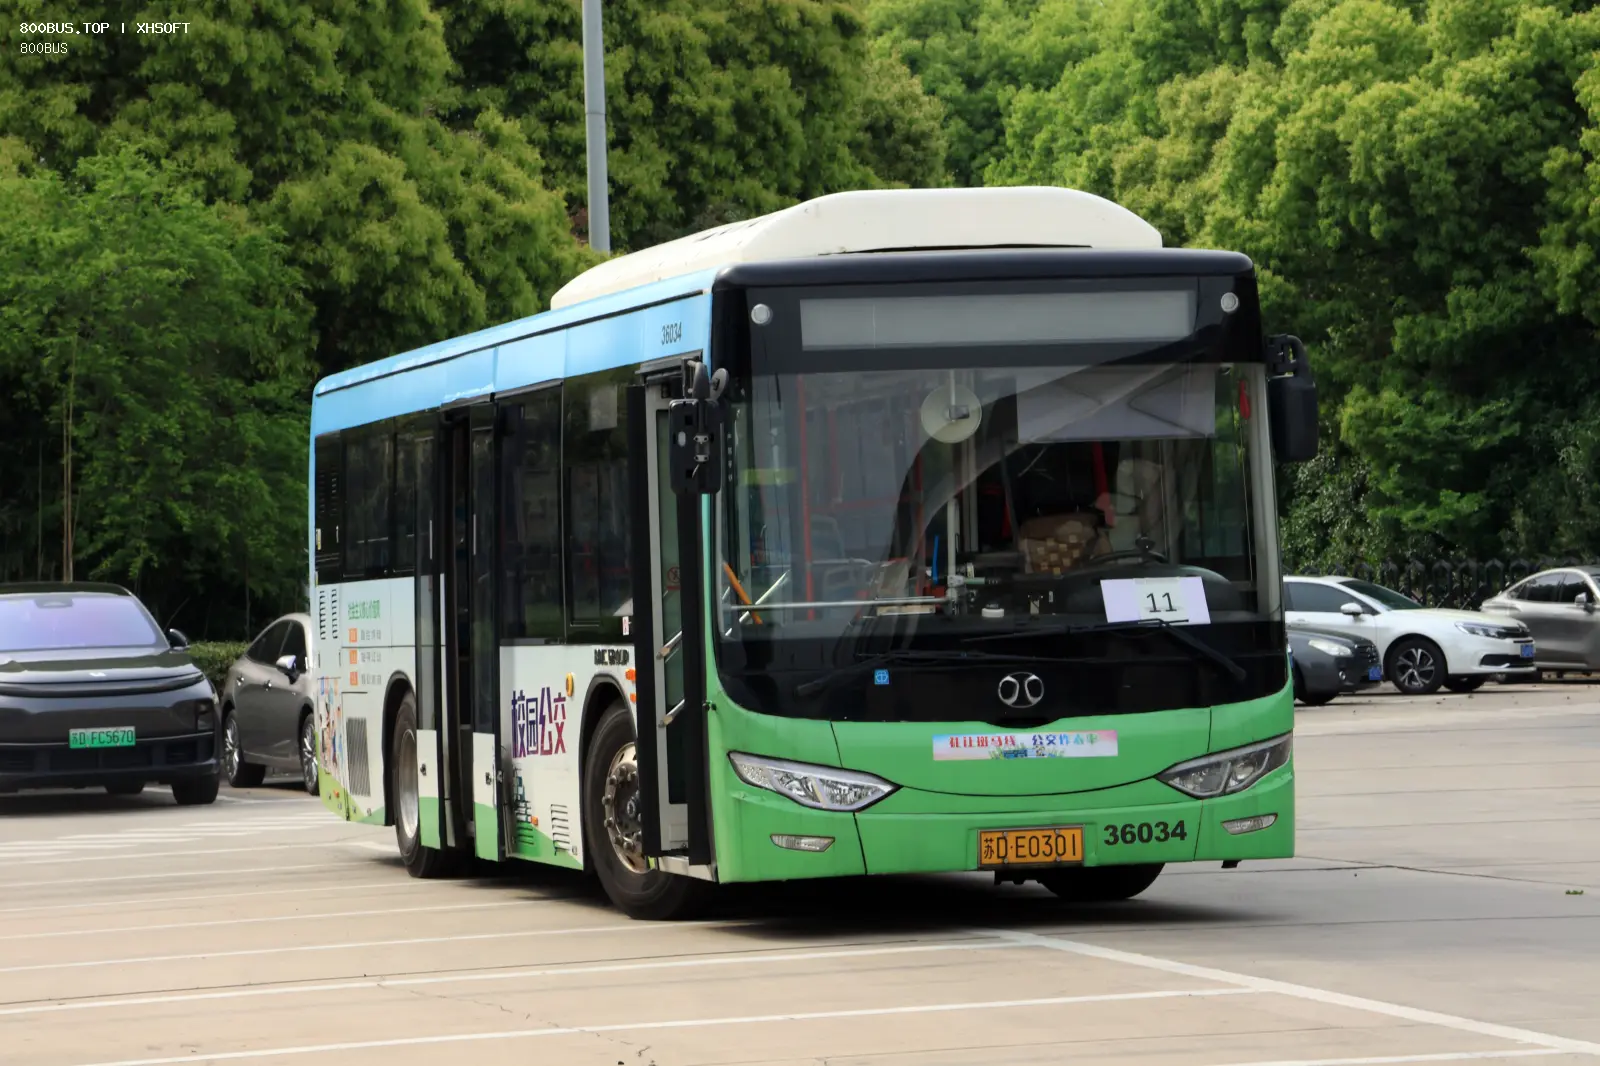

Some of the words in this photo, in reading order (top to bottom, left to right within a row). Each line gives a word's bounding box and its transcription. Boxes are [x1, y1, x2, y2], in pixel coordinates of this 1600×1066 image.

[661, 321, 682, 346] 36034
[1146, 592, 1178, 613] 11
[511, 686, 566, 758] 校园公交
[1103, 820, 1187, 846] 36034
